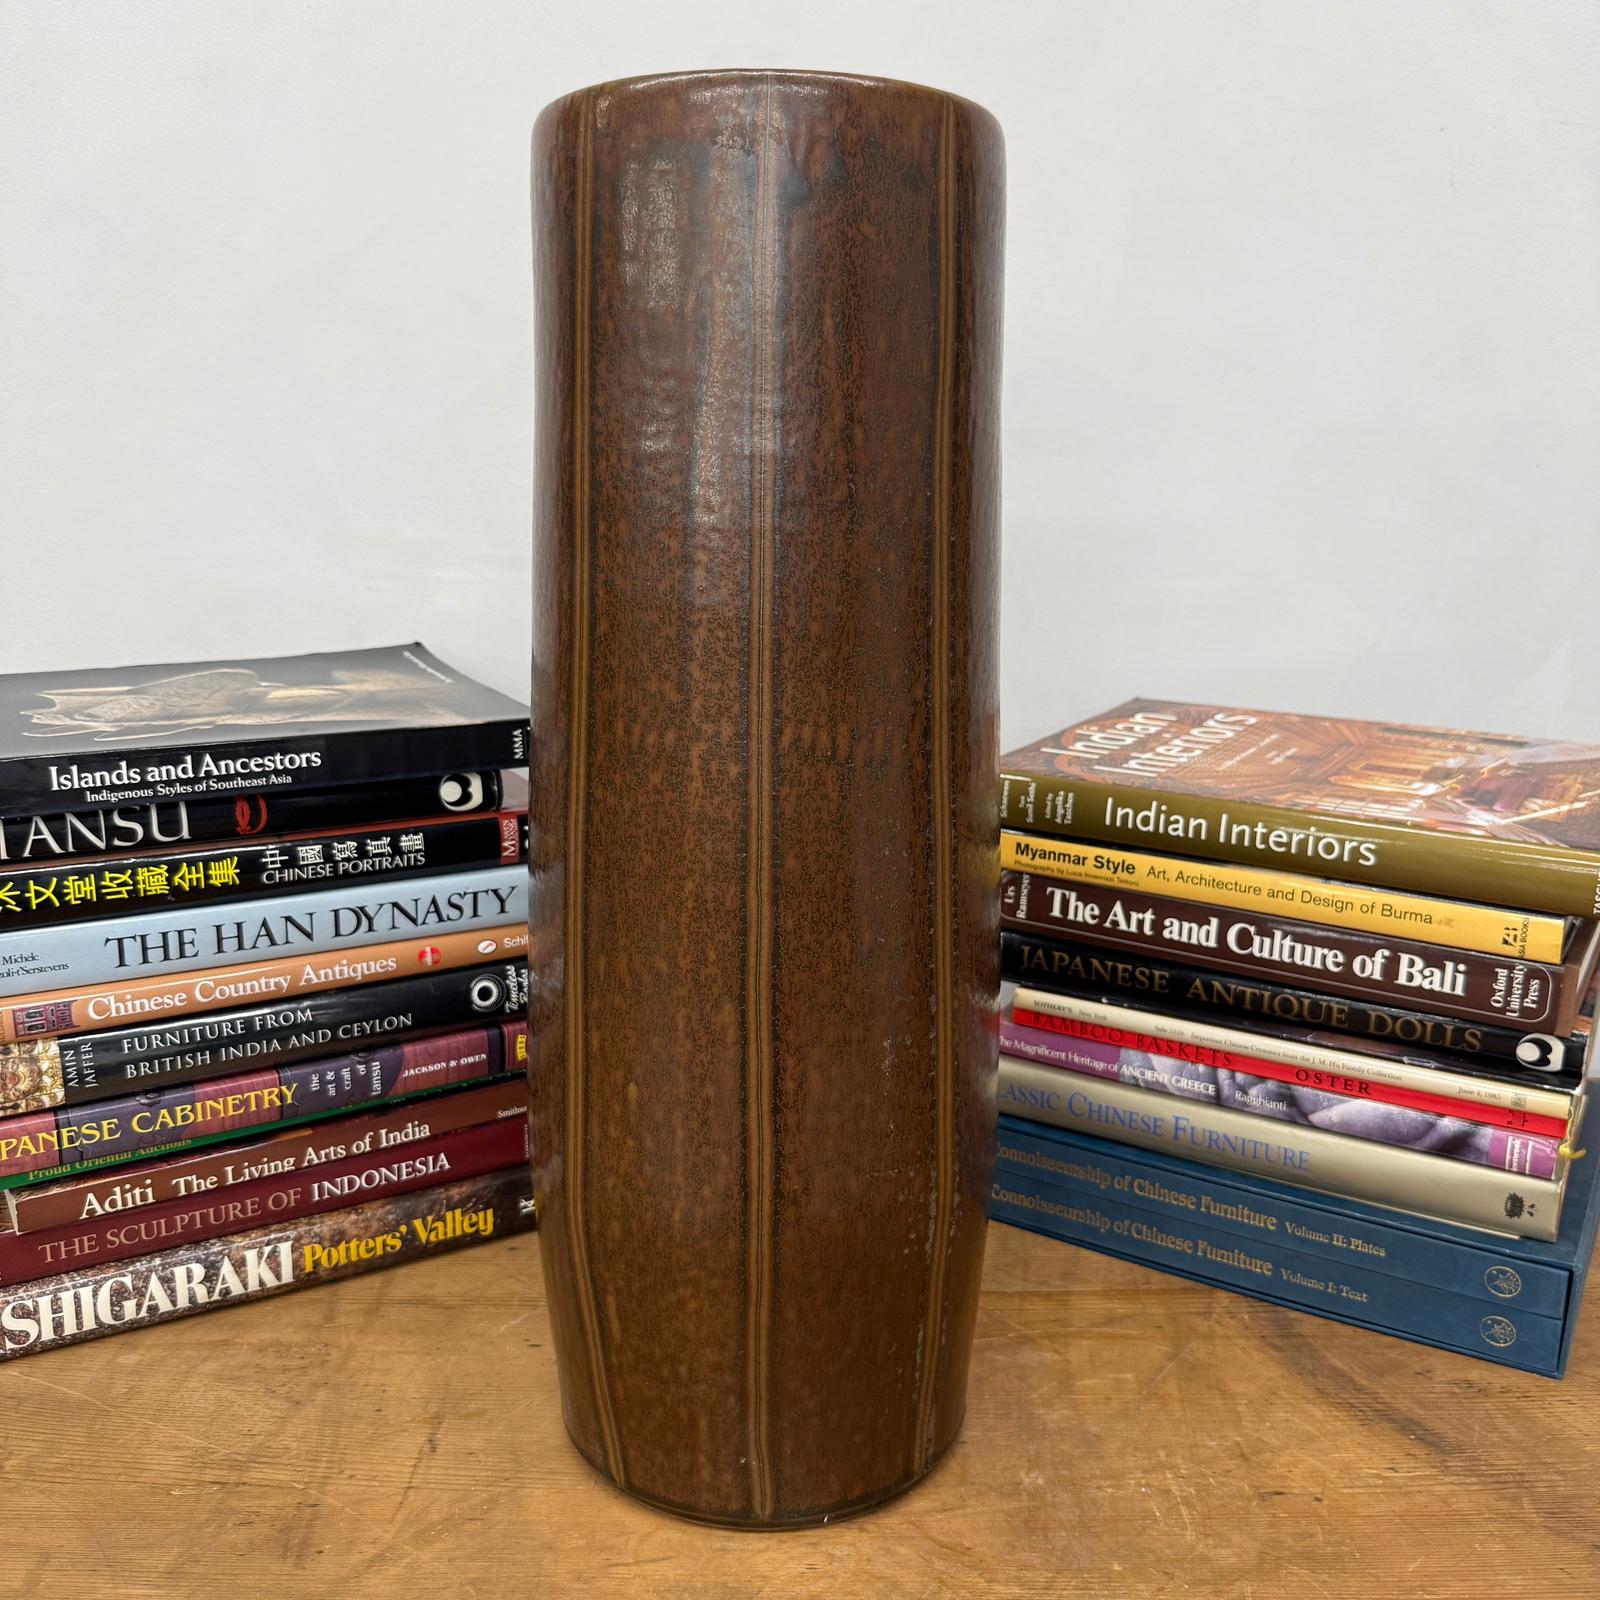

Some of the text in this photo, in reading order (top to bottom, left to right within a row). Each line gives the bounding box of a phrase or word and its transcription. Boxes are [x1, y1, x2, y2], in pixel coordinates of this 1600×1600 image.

[513, 728, 524, 760] MMA
[1040, 711, 1177, 759] Indian
[1093, 712, 1258, 777] Interiors
[49, 752, 322, 792] Islands and Ancestors
[86, 773, 292, 803] Indigenous Styles of Southeast Asia
[1104, 797, 1378, 867] Indian Interiors
[263, 852, 426, 885] CHINESE PORTRAITS
[1014, 860, 1055, 875] Photography
[1015, 842, 1434, 926] Myanmar Style Art, Architecture and Design of Burma
[104, 887, 517, 969] THE HAN DYNASTY
[1046, 885, 1467, 997] The Art and Culture of Bali
[1519, 917, 1530, 945] BOOKS
[87, 955, 397, 1020] Chinese Country Antiques
[505, 964, 519, 1013] Timeless
[1020, 945, 1482, 1052] JAPANESE ANTIQUE DOLLS
[1490, 967, 1508, 1008] Oxford
[1506, 963, 1527, 1017] University
[1523, 979, 1540, 1009] Press
[122, 1007, 314, 1055] FURNITURE FROM
[126, 1012, 414, 1080] BRITISH INDIA AND CEYLON
[1032, 1010, 1233, 1067] BAMBOO BASKETS
[64, 1050, 79, 1087] AMIN
[81, 1041, 99, 1088] JAFFER
[341, 1066, 351, 1090] craft
[356, 1063, 366, 1076] of
[371, 1061, 382, 1096] tansu
[402, 1053, 487, 1078] JACKSON & OWEN
[999, 1035, 1216, 1095] he Magnificent Heritage of ANCIENT GREECE
[1191, 1031, 1223, 1045] Important
[1224, 1038, 1250, 1050] Chinese
[1250, 1044, 1281, 1057] Ceramics
[1281, 1050, 1298, 1060] from
[1299, 1053, 1311, 1063] the
[1342, 1062, 1366, 1075] Family
[1366, 1066, 1403, 1081] Collection
[309, 1073, 320, 1091] the
[327, 1084, 336, 1096] art
[1235, 1089, 1288, 1111] Ragghianti
[1295, 1069, 1371, 1095] OSTER
[1458, 1086, 1474, 1096] June
[0, 1083, 298, 1162] PANESE CABINETRY
[999, 1082, 1311, 1171] ASSIC CHINESE FURNITURE
[28, 1162, 71, 1181] Proud
[76, 1149, 132, 1168] Oriental
[80, 1120, 431, 1220] Aditi The Living Arts of India
[39, 1152, 451, 1264] THE SCULPTURE OF INDONESIA
[1114, 1173, 1132, 1191] of
[1133, 1178, 1197, 1210] Chinese
[1200, 1194, 1278, 1231] Furniture
[1284, 1221, 1329, 1243] Volume
[1350, 1237, 1386, 1257] Plates
[0, 1207, 495, 1351] SHIGARAKI Potters' Valley
[1114, 1219, 1131, 1234] of
[1131, 1222, 1193, 1254] Chinese
[1197, 1239, 1273, 1276] Furniture
[1280, 1267, 1324, 1290] Volume
[1339, 1284, 1369, 1302] Text
